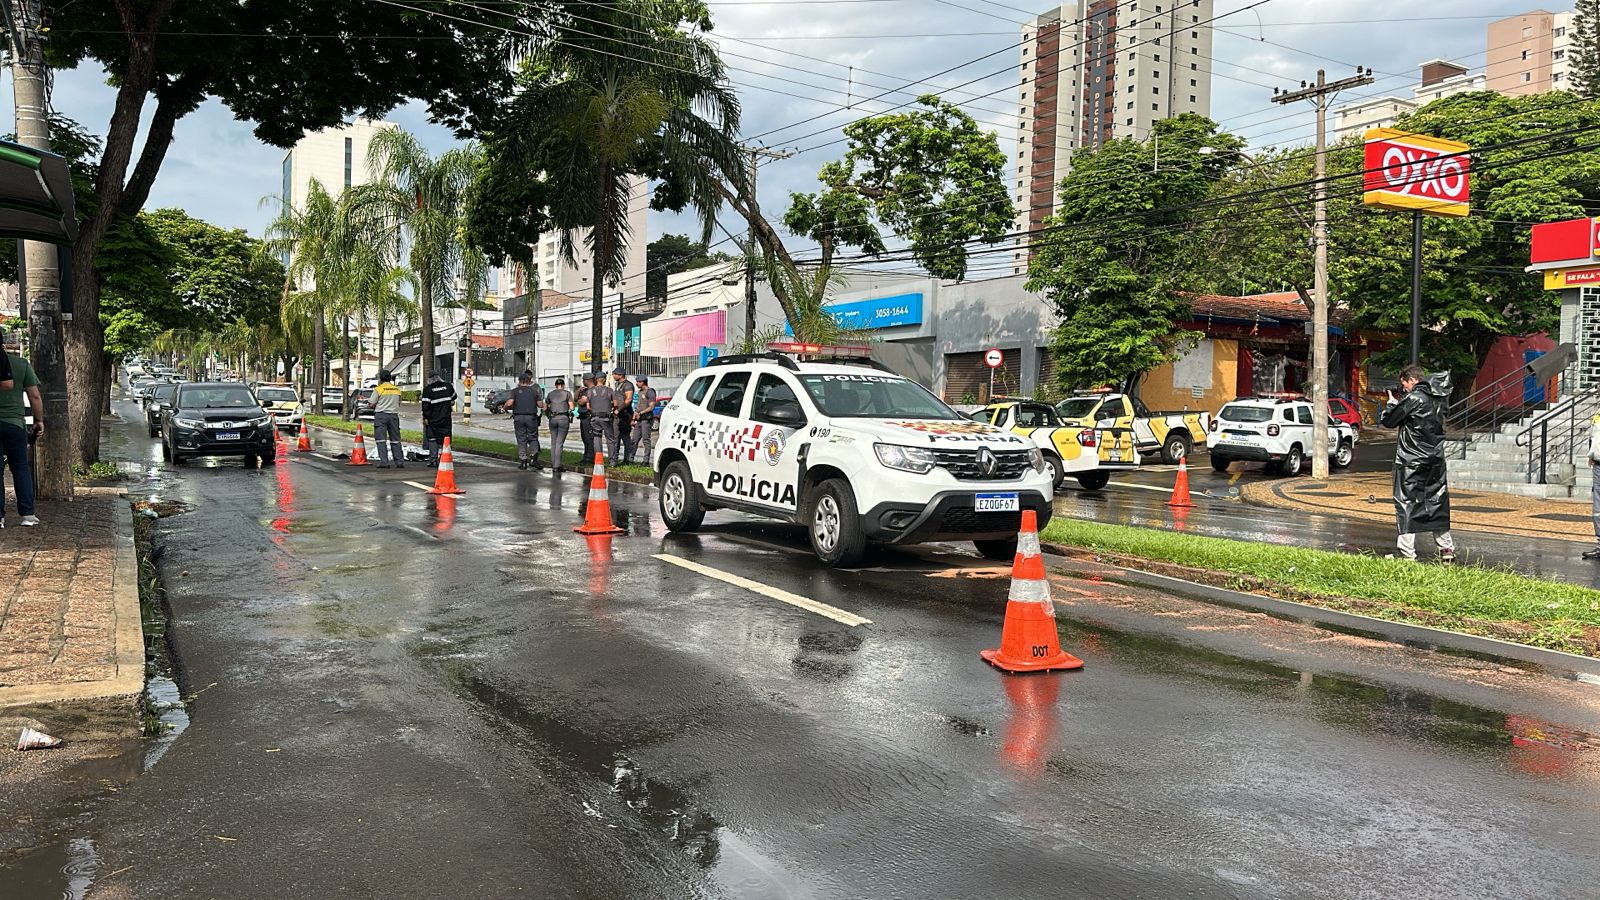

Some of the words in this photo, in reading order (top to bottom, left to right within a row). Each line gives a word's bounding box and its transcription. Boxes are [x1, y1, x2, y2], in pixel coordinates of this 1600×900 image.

[1383, 147, 1464, 197] OXXO
[817, 427, 831, 438] 190
[707, 470, 796, 506] POLÍCIA
[1032, 645, 1048, 657] DOT
